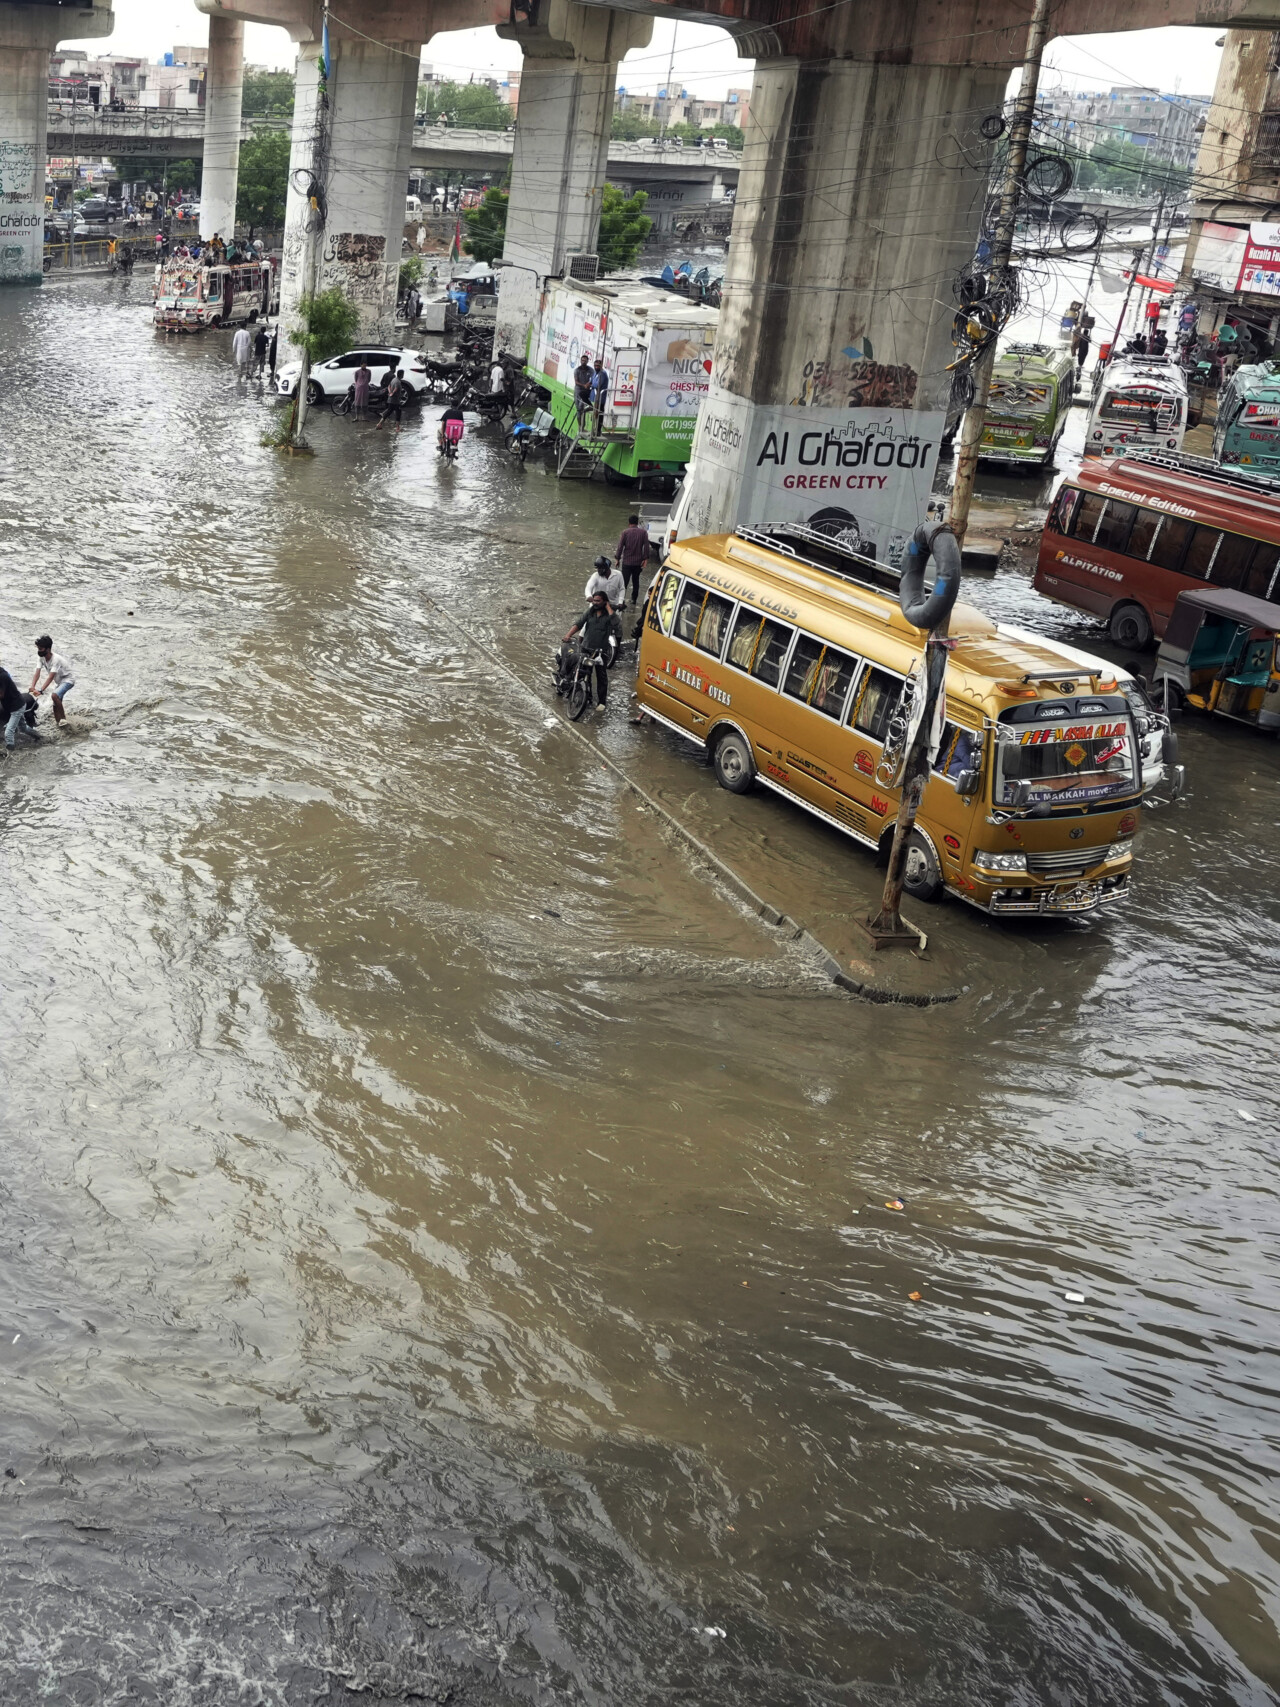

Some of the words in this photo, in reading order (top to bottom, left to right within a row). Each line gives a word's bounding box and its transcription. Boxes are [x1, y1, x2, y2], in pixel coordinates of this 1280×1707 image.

[0, 214, 41, 227] Ghafoor
[1248, 247, 1272, 261] Huzaifa
[670, 382, 696, 391] CHEST
[756, 431, 790, 466] Al
[798, 431, 932, 468] Ghafoor
[783, 474, 842, 489] GREEN
[846, 475, 888, 489] CITY
[1097, 482, 1147, 503] Special
[1148, 496, 1197, 518] Edition
[1055, 551, 1124, 582] PALPITATION
[695, 568, 760, 601] EXECUTIVE
[759, 594, 799, 620] CLASS
[702, 682, 732, 706] MOVERS
[787, 751, 827, 777] COASTER
[1027, 793, 1041, 801] AL
[1043, 789, 1086, 801] MAKKAH
